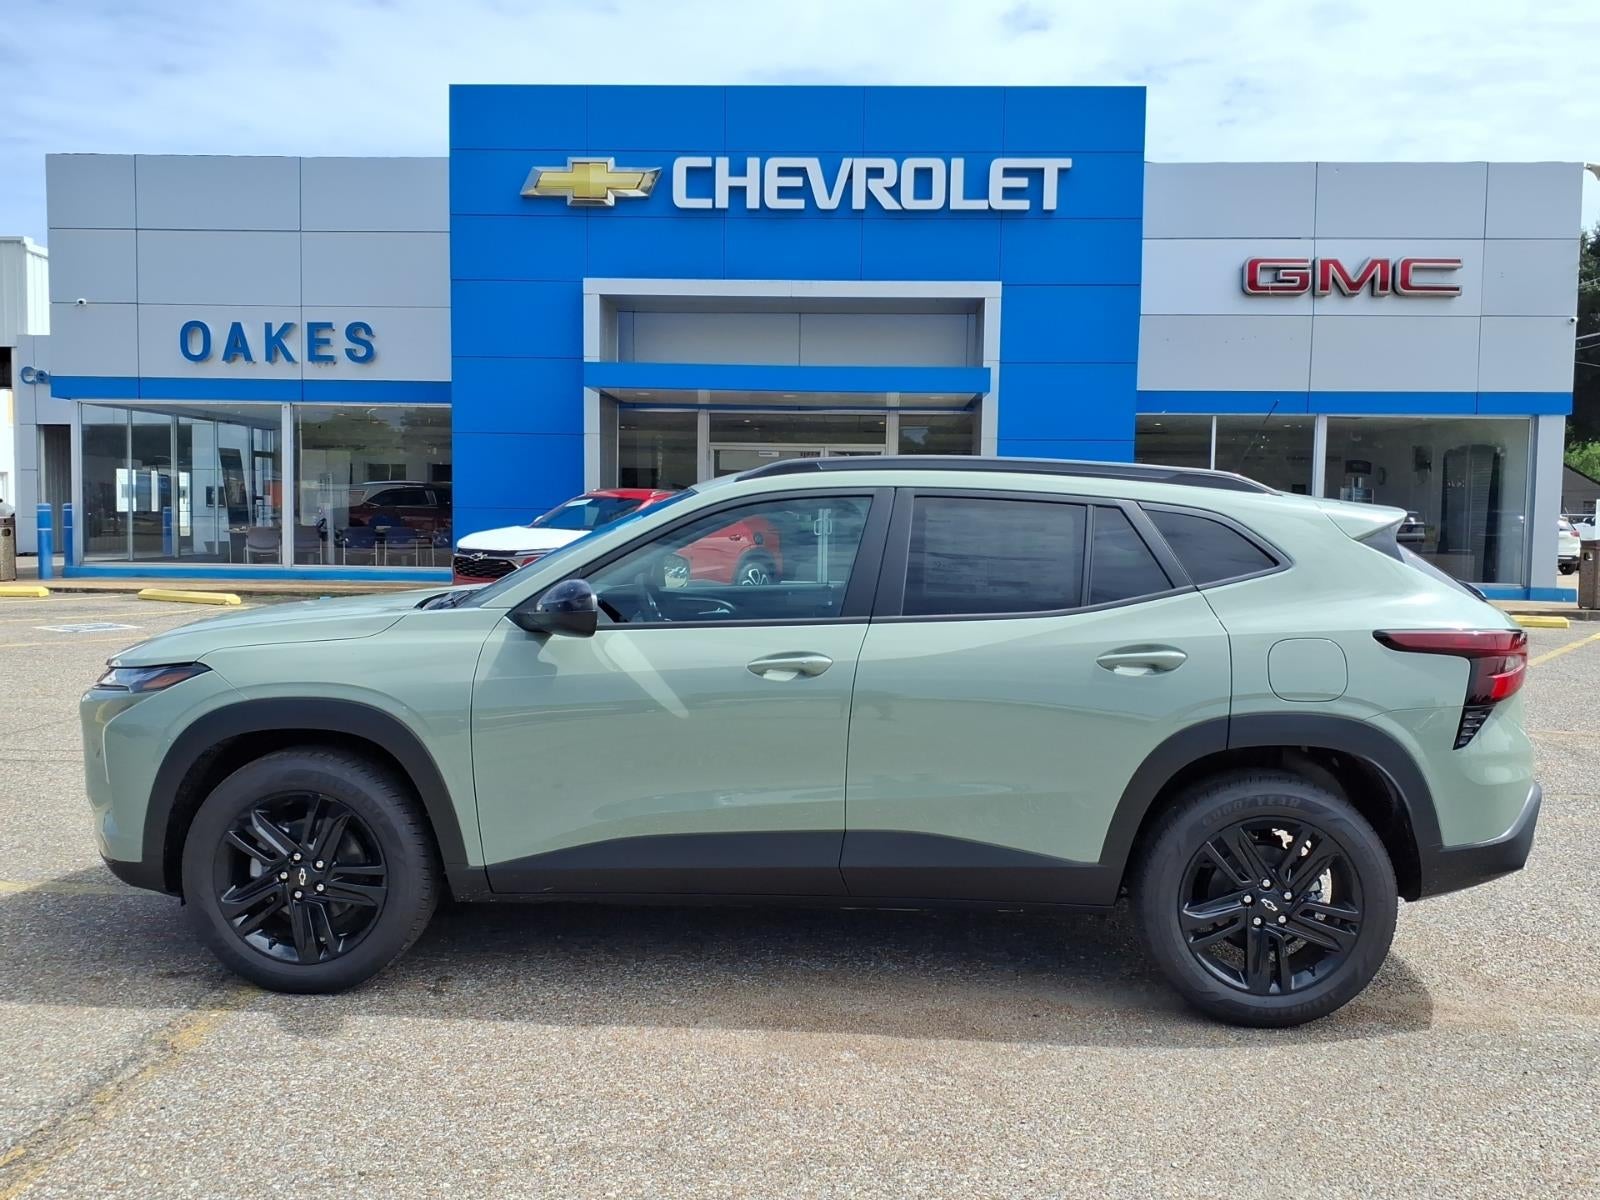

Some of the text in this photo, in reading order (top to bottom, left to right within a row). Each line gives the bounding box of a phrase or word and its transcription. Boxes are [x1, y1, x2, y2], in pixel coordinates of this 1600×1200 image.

[672, 156, 1073, 211] CHEVROLET
[1242, 256, 1463, 297] GMC
[179, 320, 376, 365] OAKES
